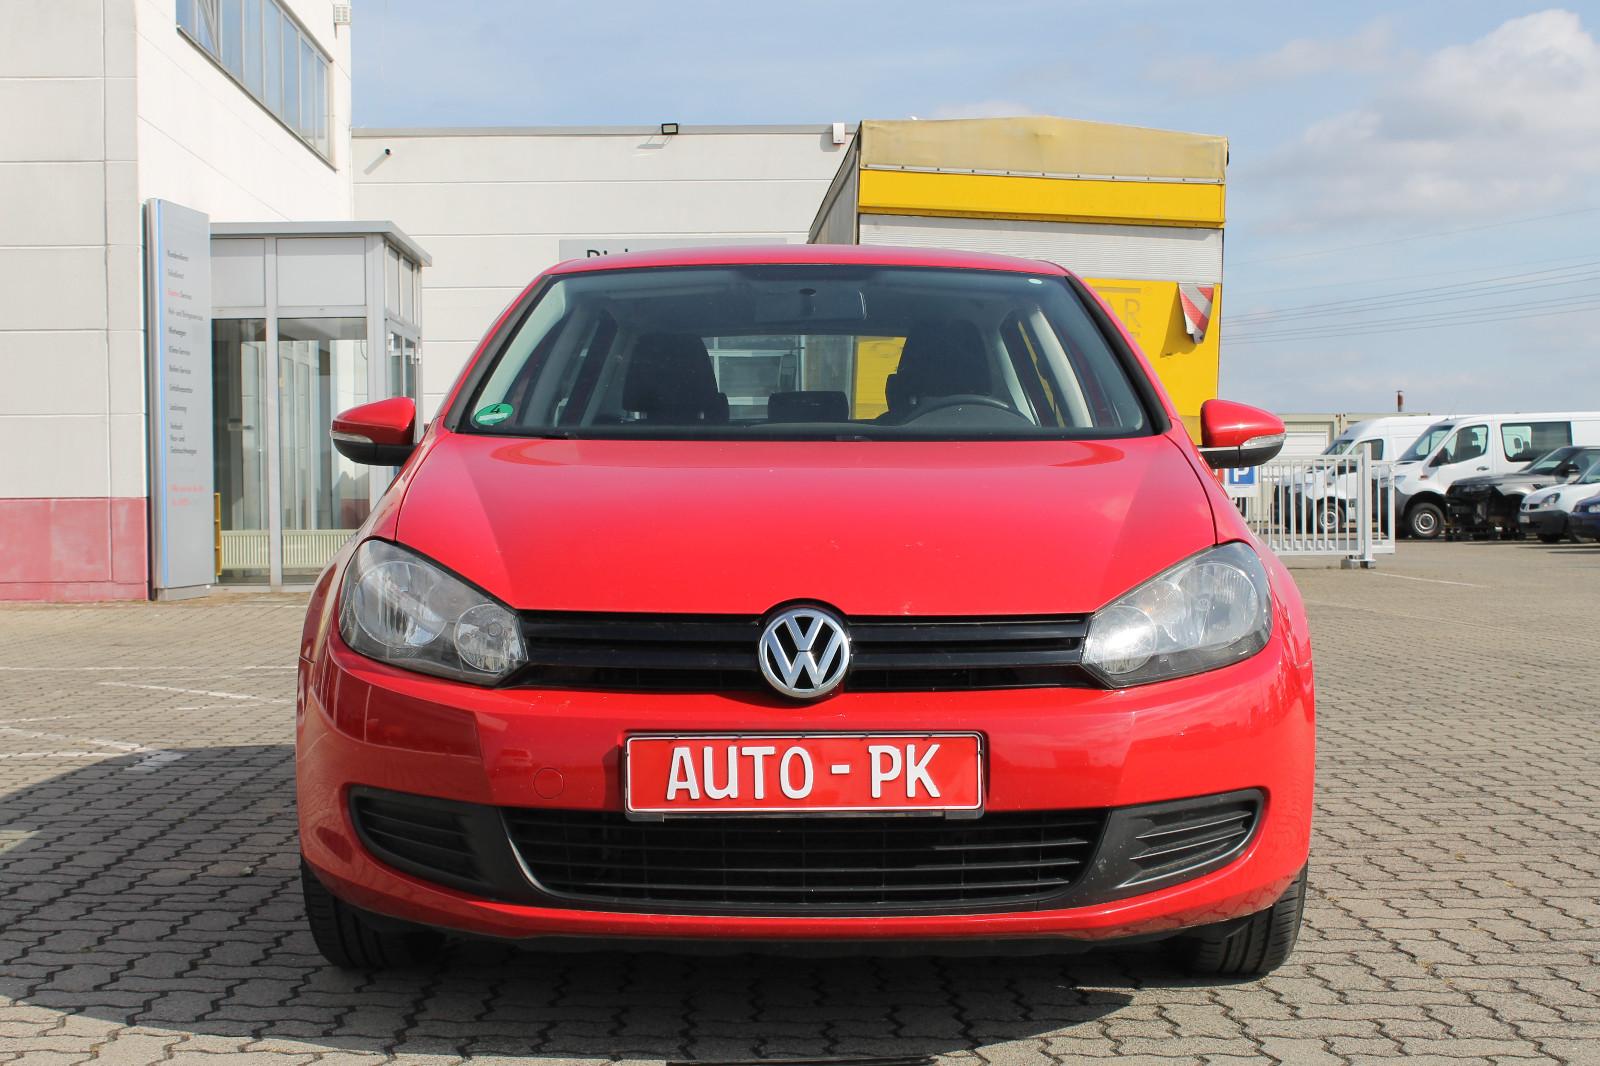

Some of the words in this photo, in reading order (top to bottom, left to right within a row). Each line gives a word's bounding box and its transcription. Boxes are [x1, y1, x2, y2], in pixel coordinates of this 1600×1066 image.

[490, 404, 501, 414] 4
[1233, 467, 1250, 482] P
[666, 746, 814, 801] AUTO
[868, 744, 941, 800] PK
